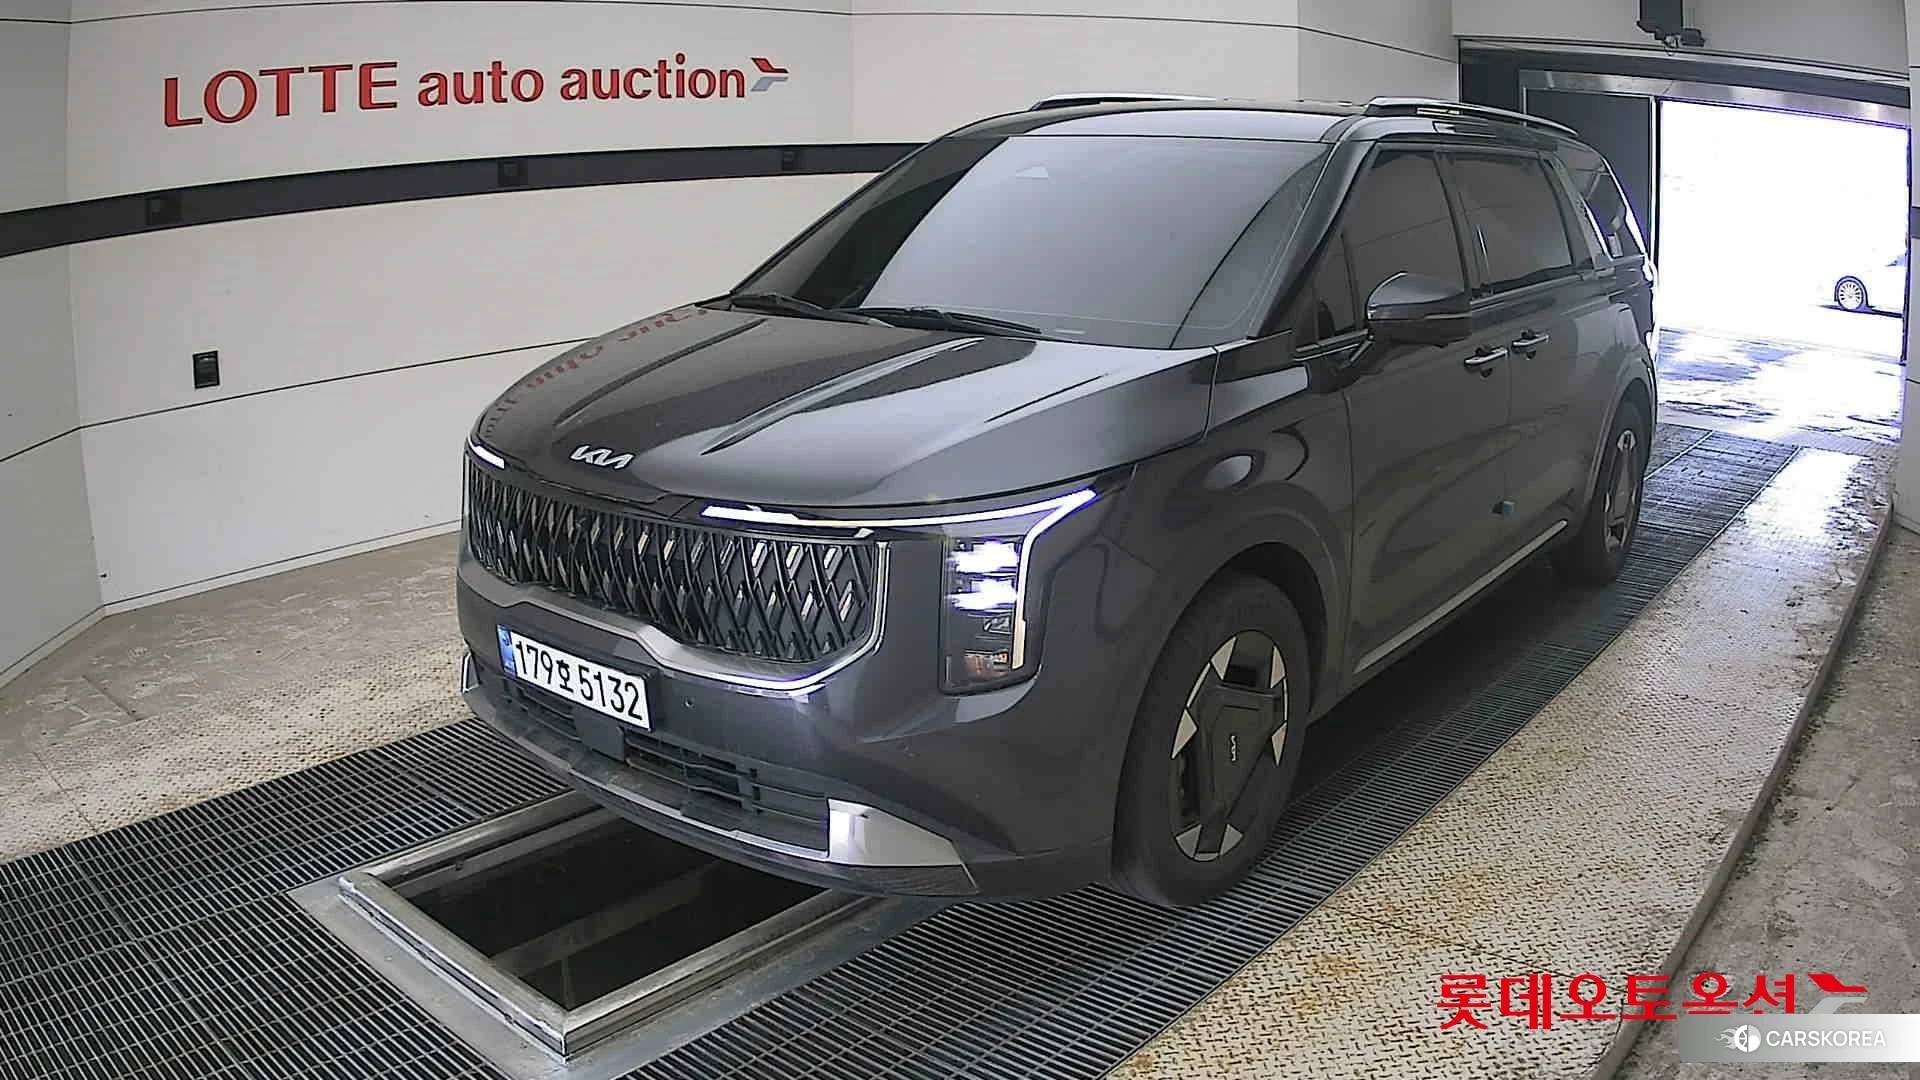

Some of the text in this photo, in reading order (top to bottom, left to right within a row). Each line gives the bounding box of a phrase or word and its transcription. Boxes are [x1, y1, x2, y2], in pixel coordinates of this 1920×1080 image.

[163, 52, 746, 128] LOTTE auto auction
